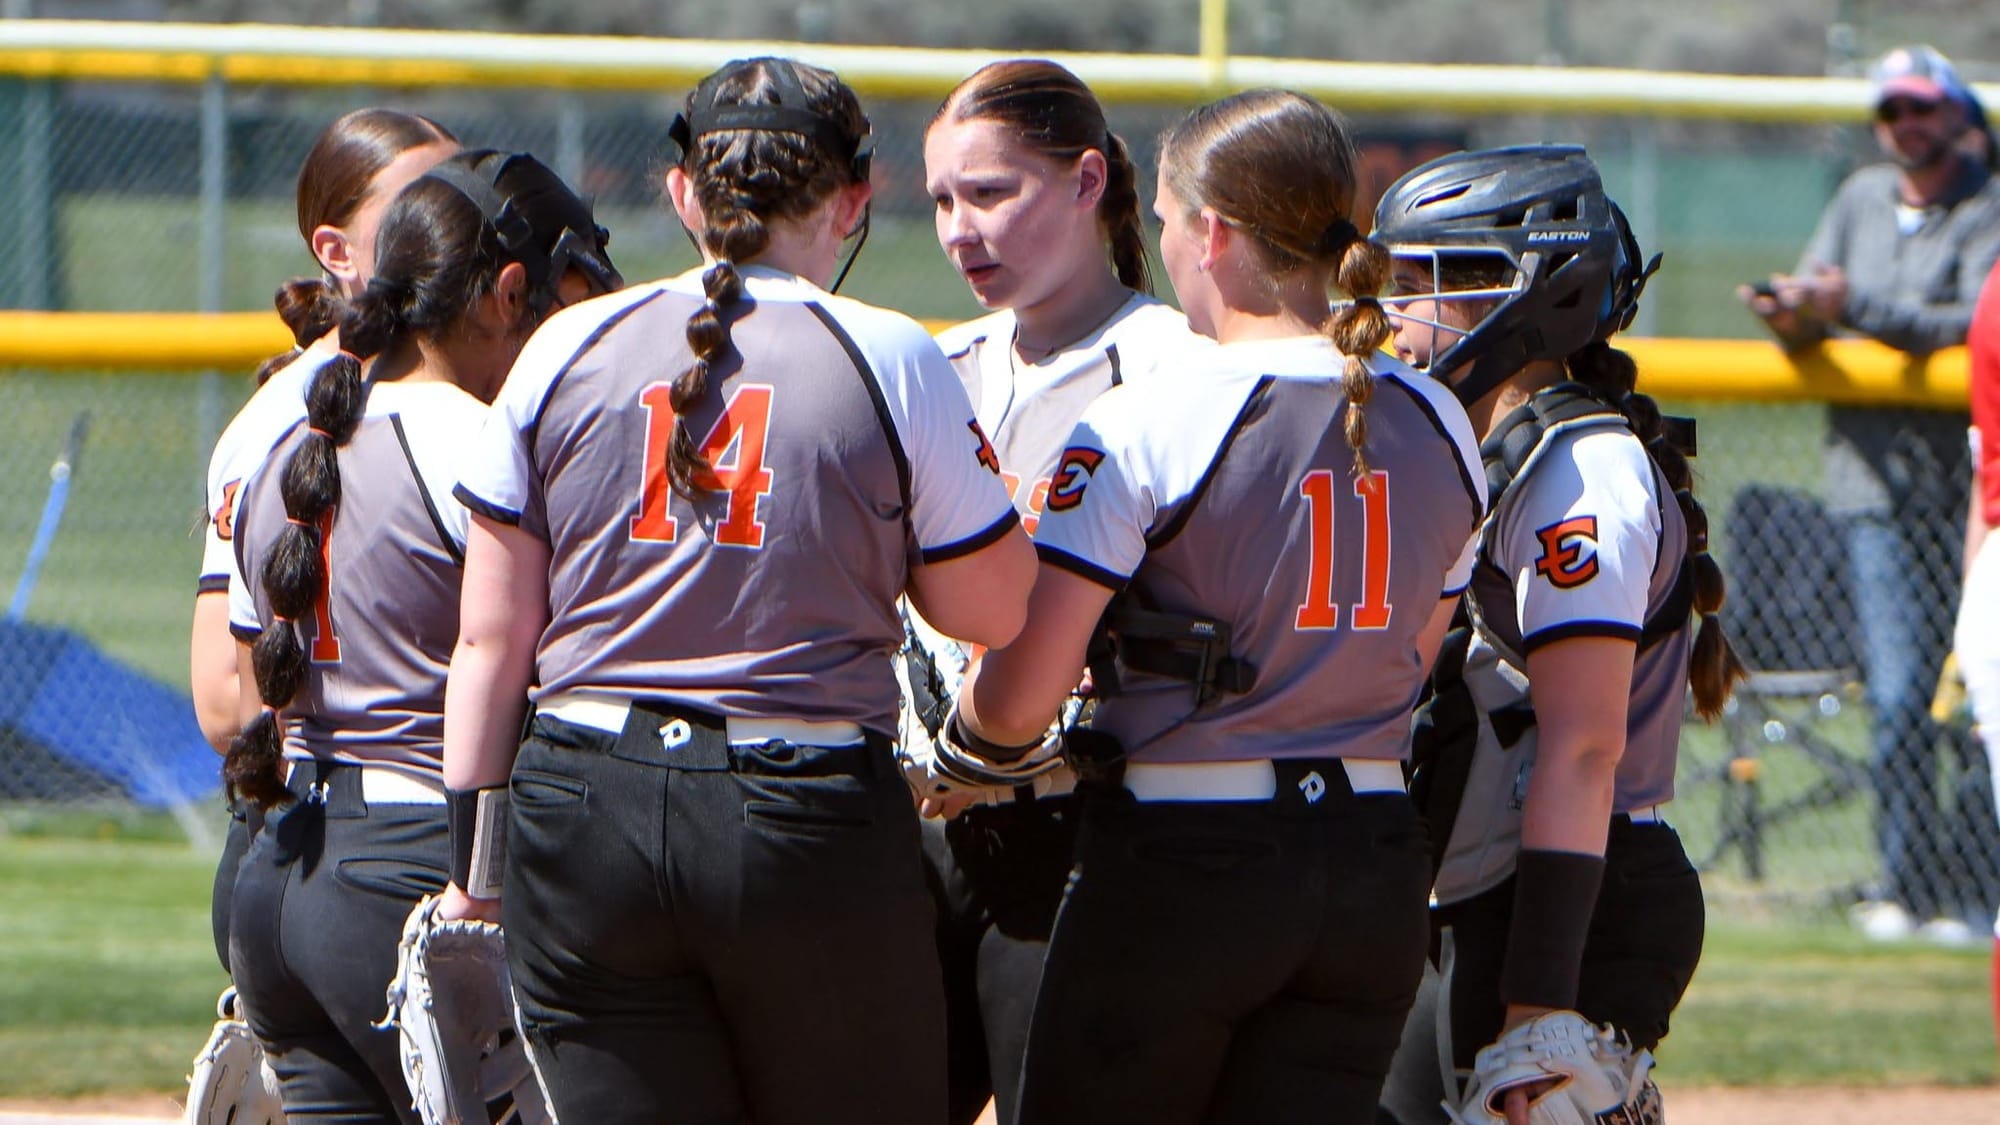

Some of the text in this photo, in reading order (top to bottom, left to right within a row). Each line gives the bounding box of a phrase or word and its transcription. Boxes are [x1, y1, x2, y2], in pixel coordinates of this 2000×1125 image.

[1527, 231, 1591, 242] EASTON
[629, 379, 775, 549] 14
[1294, 470, 1393, 630] 11
